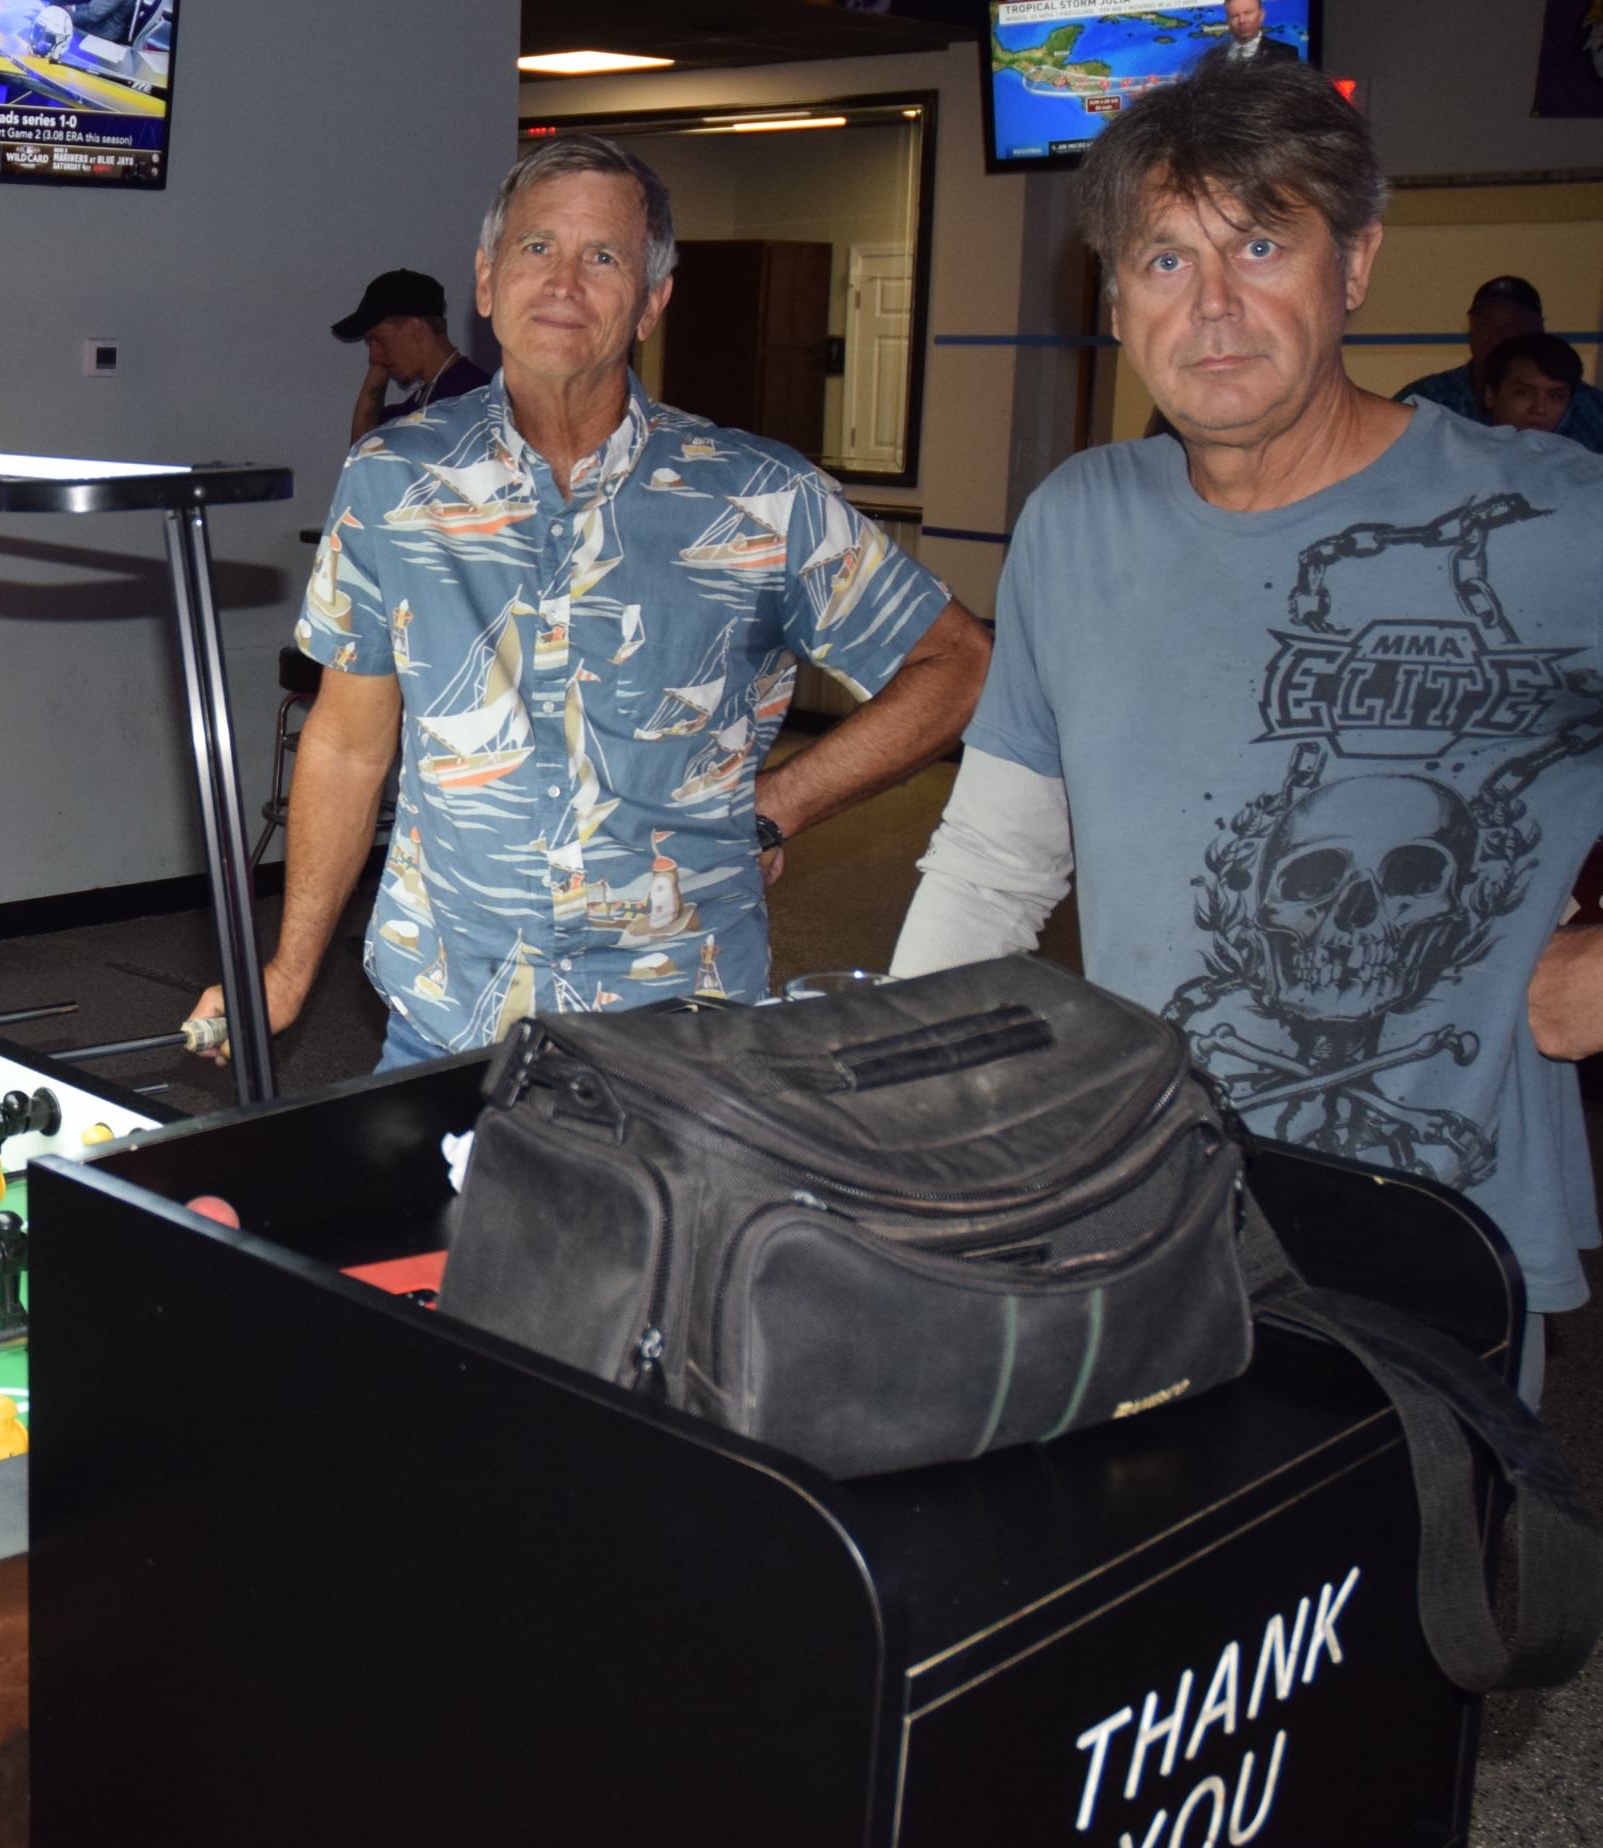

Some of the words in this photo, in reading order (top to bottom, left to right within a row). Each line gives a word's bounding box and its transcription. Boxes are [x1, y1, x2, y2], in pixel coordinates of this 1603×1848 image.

[1006, 3, 1056, 15] TROPICAL
[1060, 0, 1097, 9] STORM
[22, 112, 56, 127] series
[59, 115, 78, 128] 1-0
[7, 127, 33, 140] Game
[35, 130, 41, 140] 2
[43, 129, 65, 142] (3.08
[66, 131, 84, 142] ERA
[85, 132, 102, 144] this
[102, 134, 133, 146] season)
[53, 153, 88, 164] MARINERS
[97, 154, 115, 166] BLUE
[117, 156, 134, 167] JAYS
[1370, 634, 1464, 660] MMA
[1270, 646, 1564, 736] ELITE
[1076, 1566, 1360, 1831] THANK
